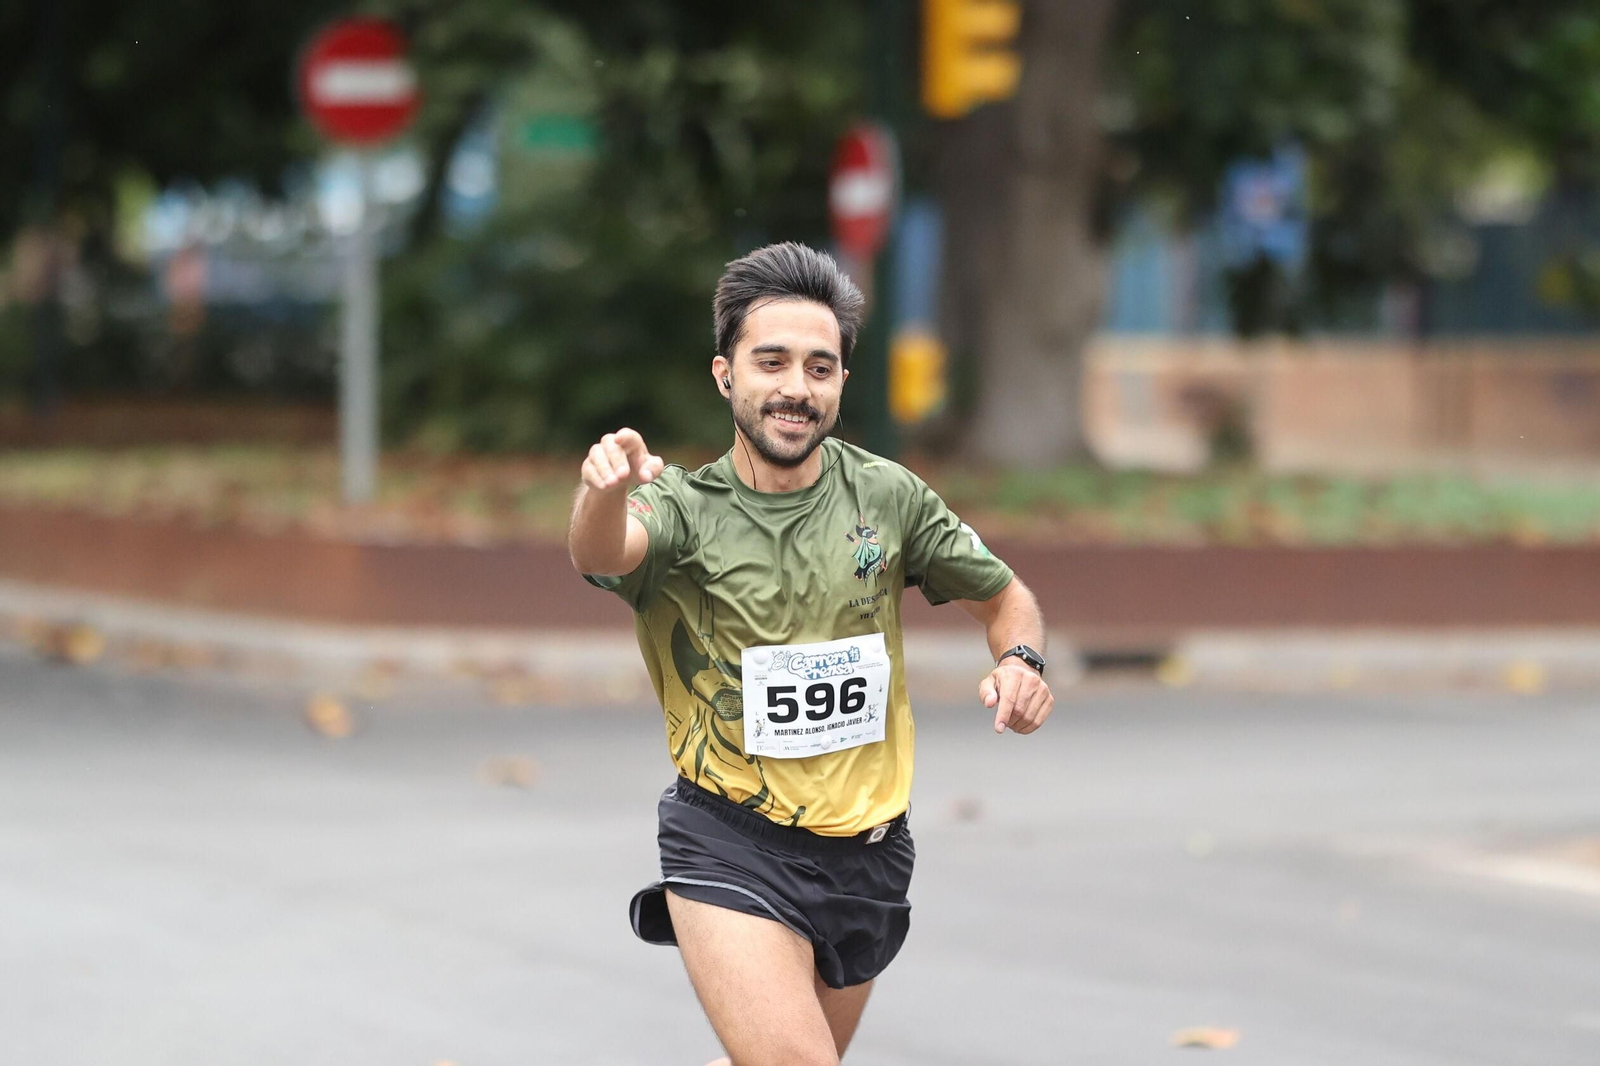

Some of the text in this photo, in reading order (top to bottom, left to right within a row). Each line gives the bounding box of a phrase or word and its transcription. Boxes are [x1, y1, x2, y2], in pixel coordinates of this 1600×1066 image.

[849, 599, 860, 608] LA
[791, 652, 849, 670] Carrera
[803, 662, 853, 680] Prensa
[767, 677, 867, 723] 596
[774, 728, 804, 736] MARTINEZ
[826, 720, 846, 732] IGNACIO
[846, 717, 862, 728] JAVIER
